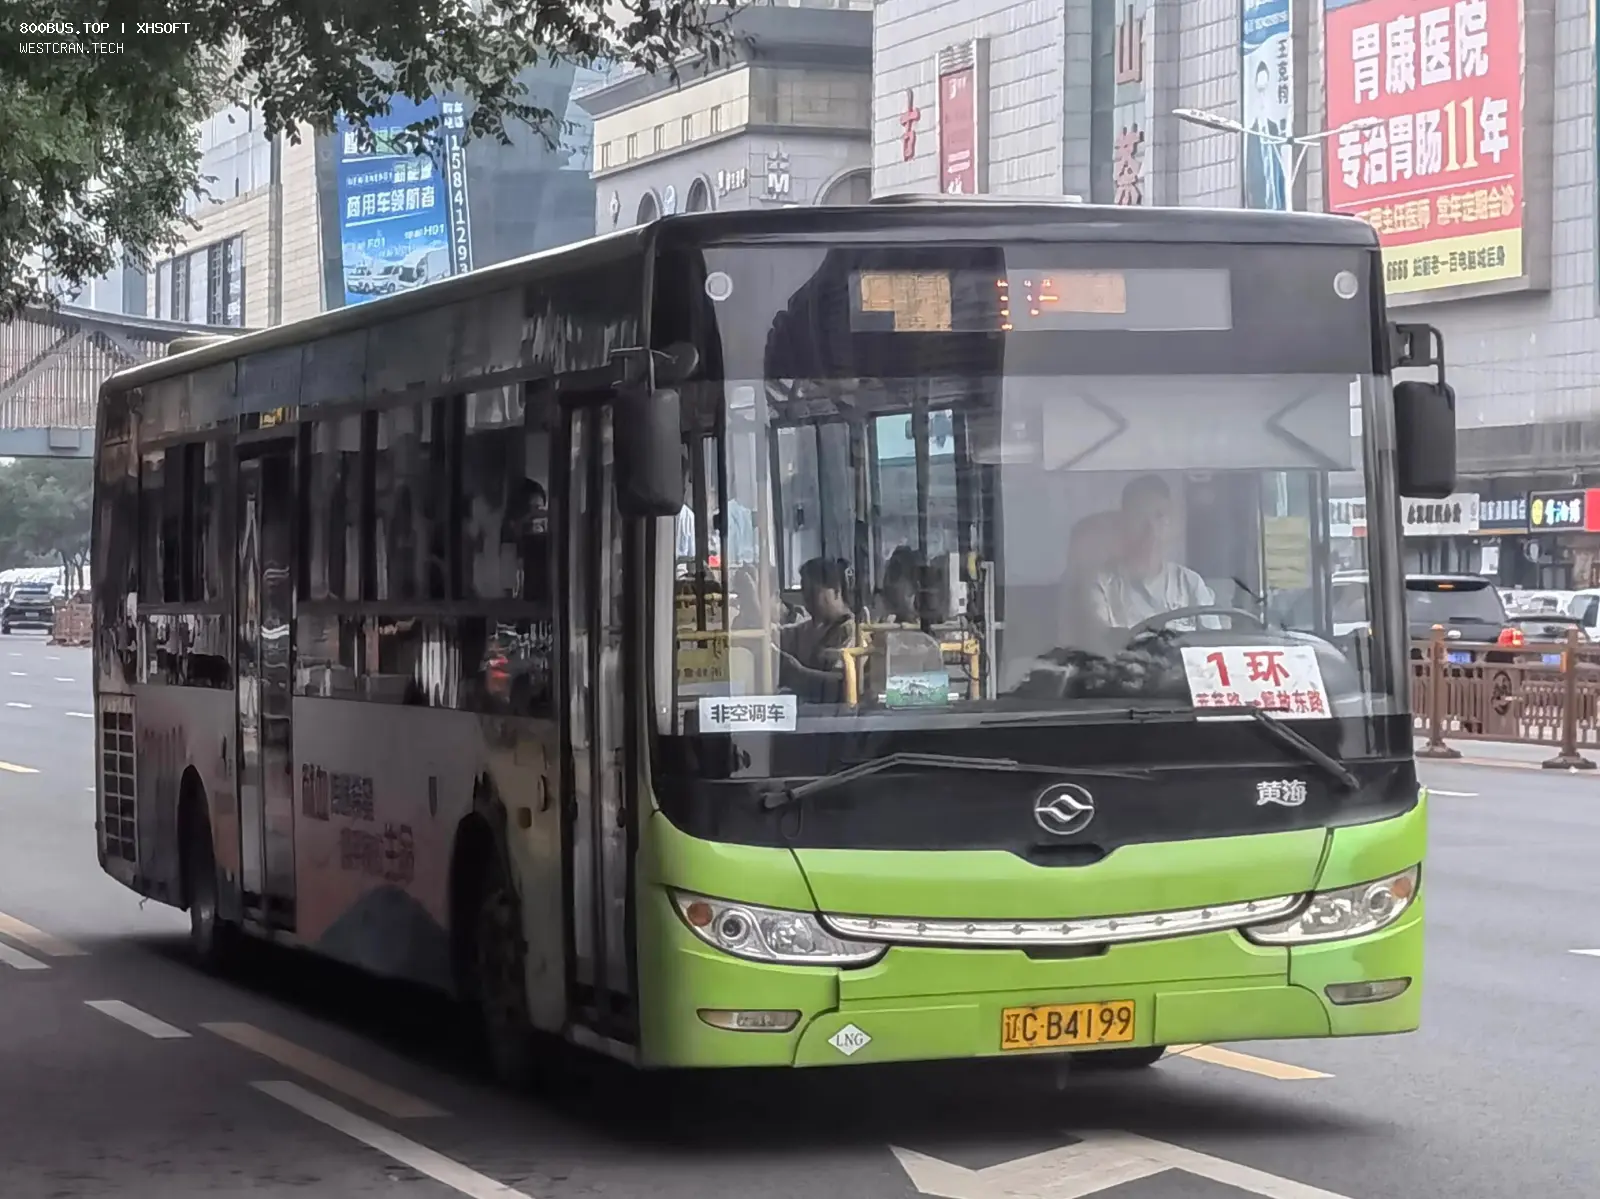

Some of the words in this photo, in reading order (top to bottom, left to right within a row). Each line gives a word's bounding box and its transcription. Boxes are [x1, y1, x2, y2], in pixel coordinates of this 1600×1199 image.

[1352, 1, 1490, 104] 胃康医院
[1338, 97, 1509, 189] 专治胃肠11年
[710, 703, 785, 723] 非空调车
[1256, 779, 1307, 807] 黄海
[836, 1032, 864, 1046] LNG
